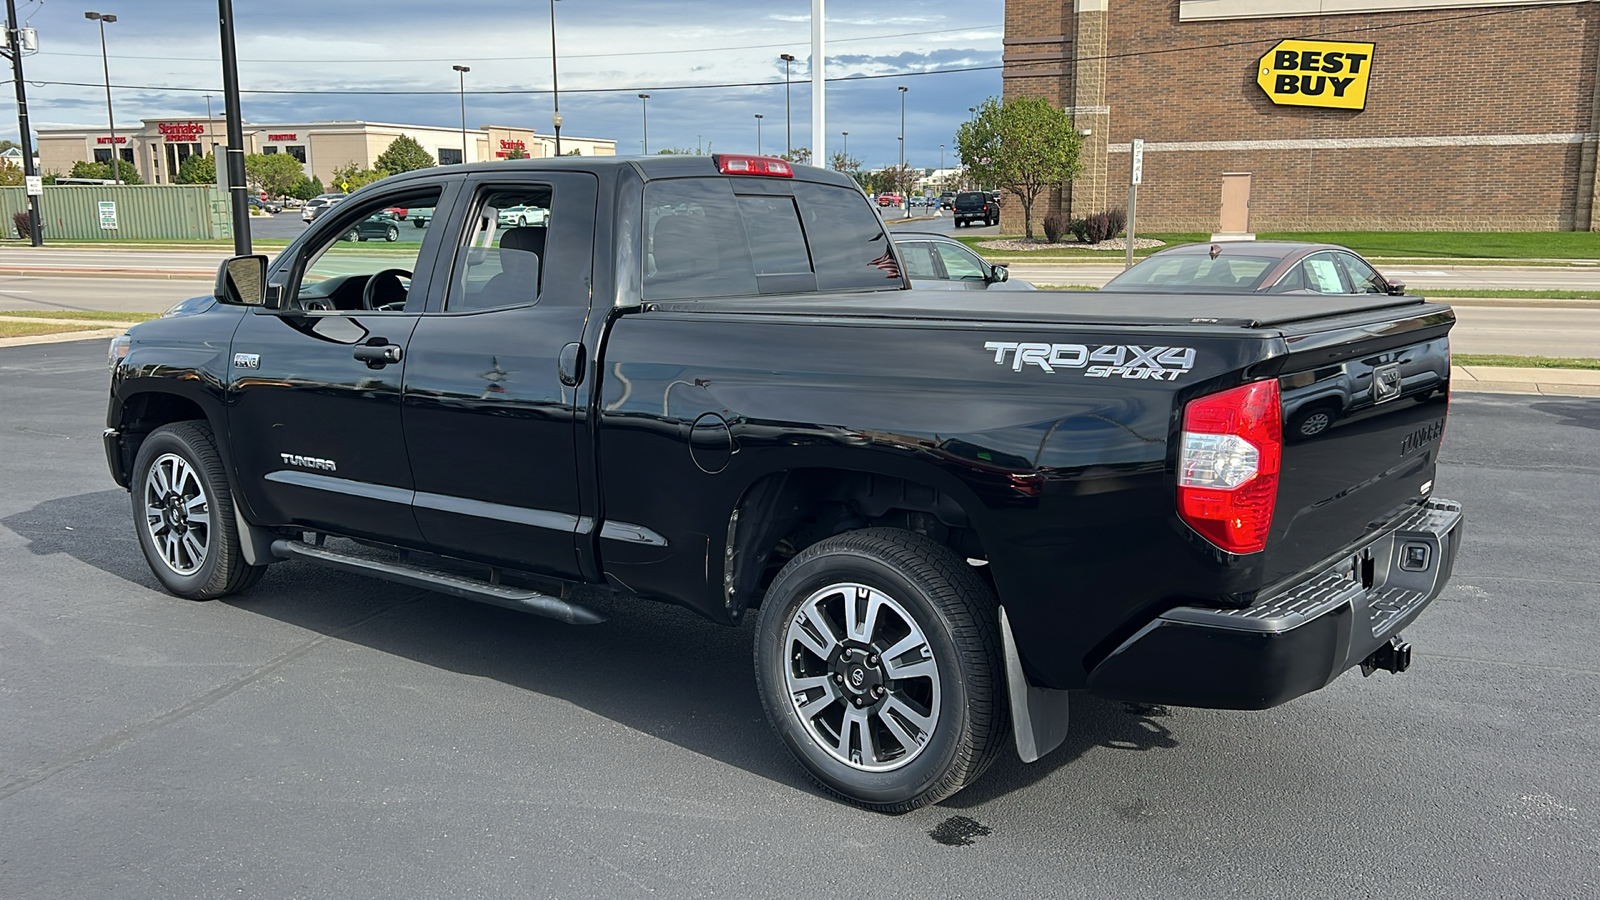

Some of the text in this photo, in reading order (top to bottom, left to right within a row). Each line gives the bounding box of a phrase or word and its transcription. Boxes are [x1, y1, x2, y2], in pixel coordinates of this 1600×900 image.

[1273, 50, 1368, 74] BEST
[1273, 74, 1356, 97] BUY
[158, 121, 204, 134] Steinhafels
[165, 134, 197, 142] SUPERSTORE
[984, 341, 1090, 374] TRD
[1084, 365, 1189, 381] SPORT
[280, 453, 337, 471] TUNDRA
